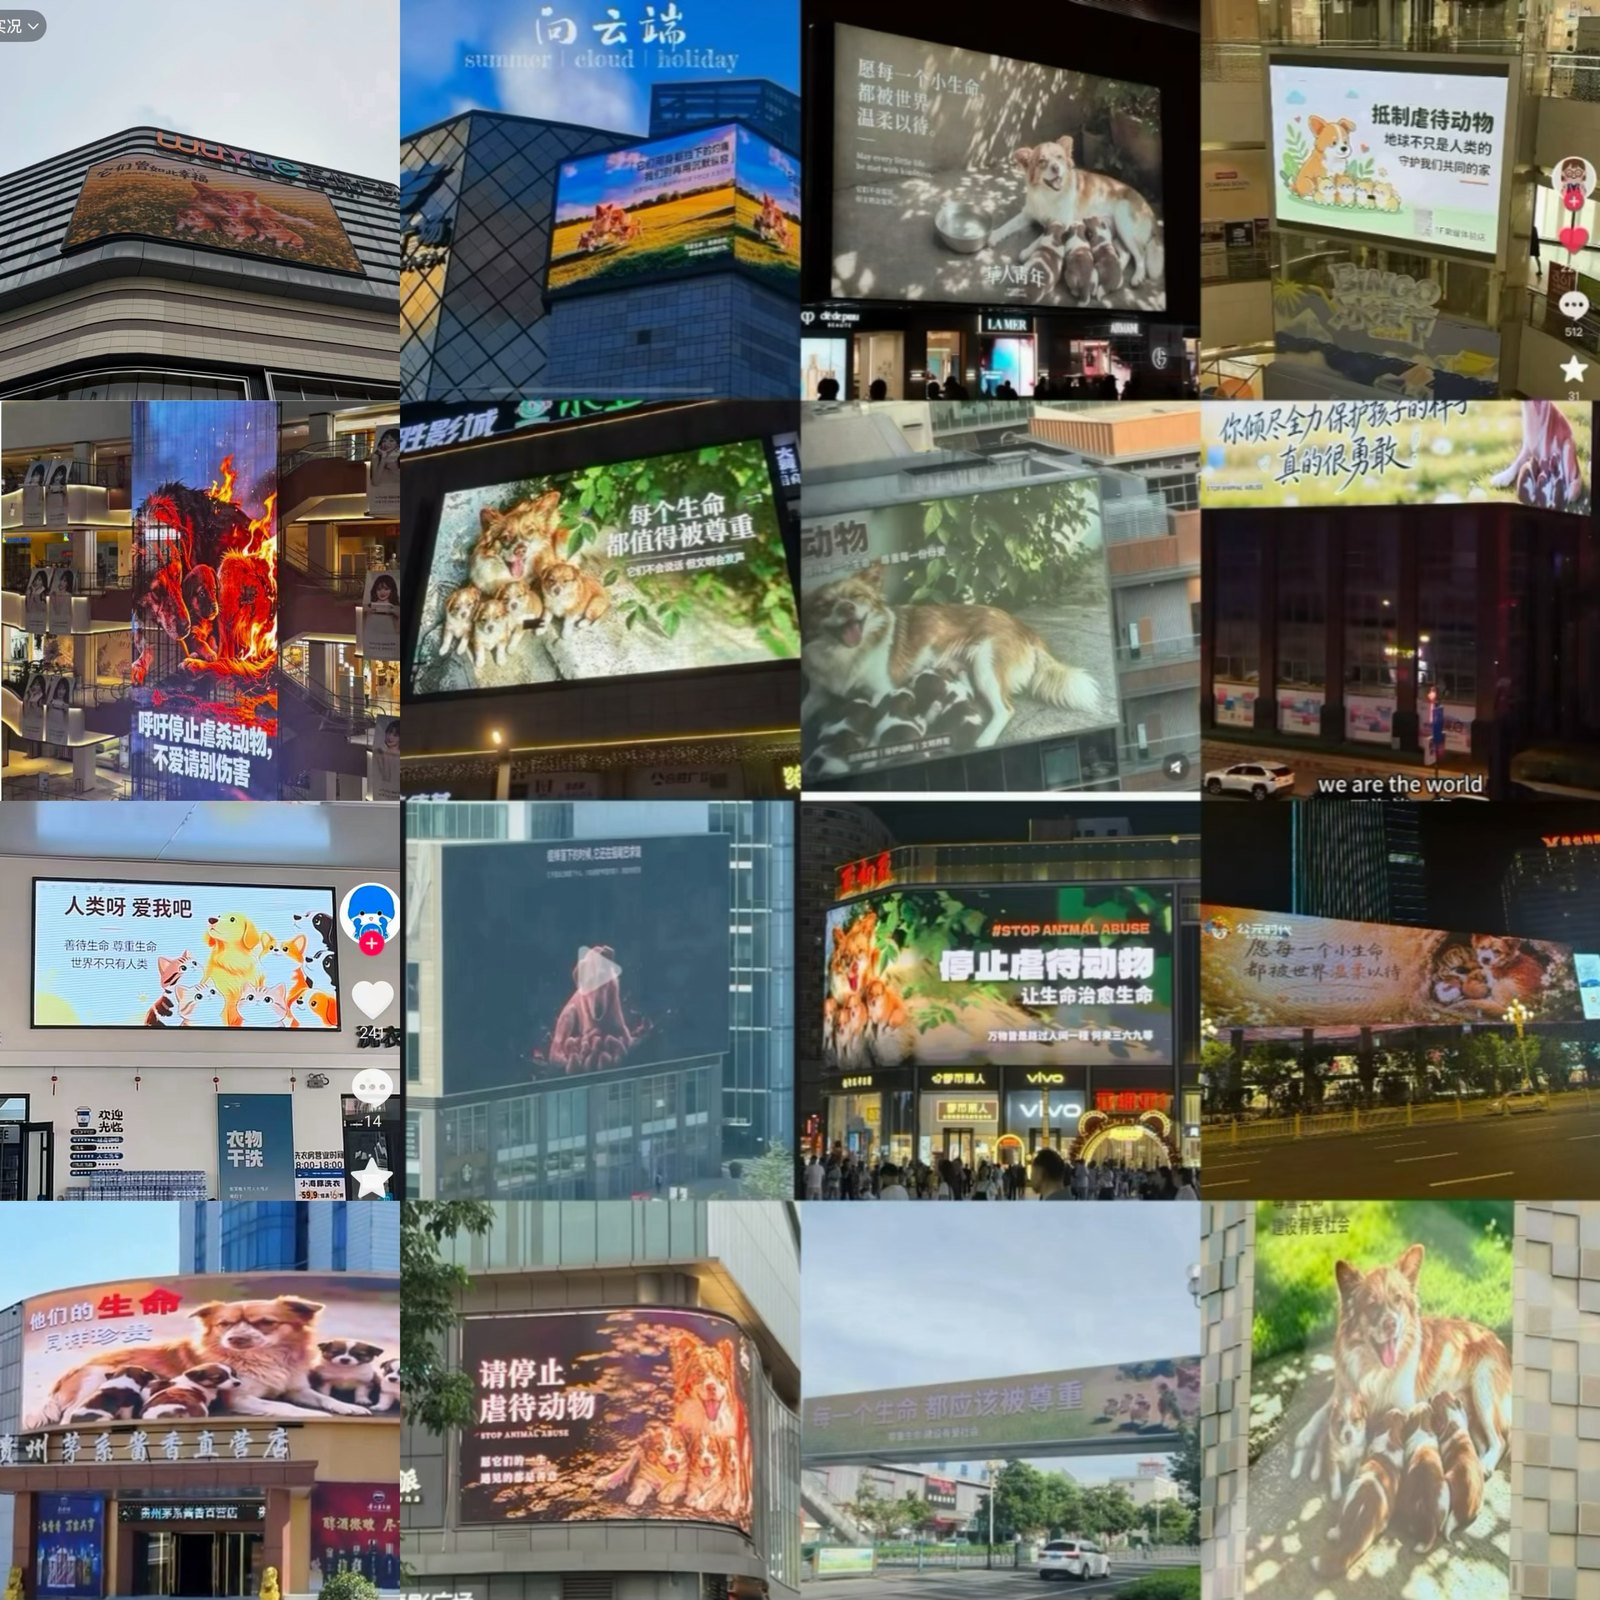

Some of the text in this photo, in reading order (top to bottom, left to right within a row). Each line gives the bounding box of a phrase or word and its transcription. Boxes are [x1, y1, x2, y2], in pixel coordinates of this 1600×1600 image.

[858, 83, 929, 112] 都被世界
[1372, 104, 1494, 134] 抵制虐待动物
[1384, 133, 1492, 156] 地球不只是人类的
[1399, 155, 1491, 176] 守护我们共同的家
[988, 319, 1027, 331] LA MER
[629, 492, 725, 526] 每个生命
[607, 513, 756, 558] 都值得被尊重
[800, 520, 868, 558] 动物
[153, 744, 250, 788] 不爱请别伤害
[64, 895, 193, 918] 人类呀 爱我吧
[992, 923, 1150, 936] #STOP ANIMAL ABUSE
[1236, 924, 1292, 936] 公元时代
[64, 939, 157, 952] 善待生命 尊重生命
[1244, 939, 1384, 960] 愿每一个小生命
[71, 957, 148, 970] 世界不只有人类
[939, 947, 1154, 982] 停止虐待动物
[1243, 961, 1401, 982] 都被世界温柔以待
[1021, 986, 1154, 1005] 让生命治愈生命
[1026, 1072, 1064, 1083] vivo
[98, 1109, 123, 1121] 欢迎
[1019, 1100, 1082, 1117] vivo
[98, 1121, 123, 1133] 光临
[227, 1131, 263, 1149] 衣物
[227, 1150, 264, 1168] 干洗
[1272, 1216, 1350, 1235] 建设有爱社会
[45, 1323, 153, 1353] 同样珍贵
[479, 1358, 565, 1389] 请停止
[479, 1392, 595, 1424] 虐待动物
[812, 1380, 1085, 1429] 每一个生命 都应该被尊重
[480, 1429, 569, 1440] STOP ANIMAL ABUSE
[0, 1428, 290, 1464] 贵州茅系酱香直营店
